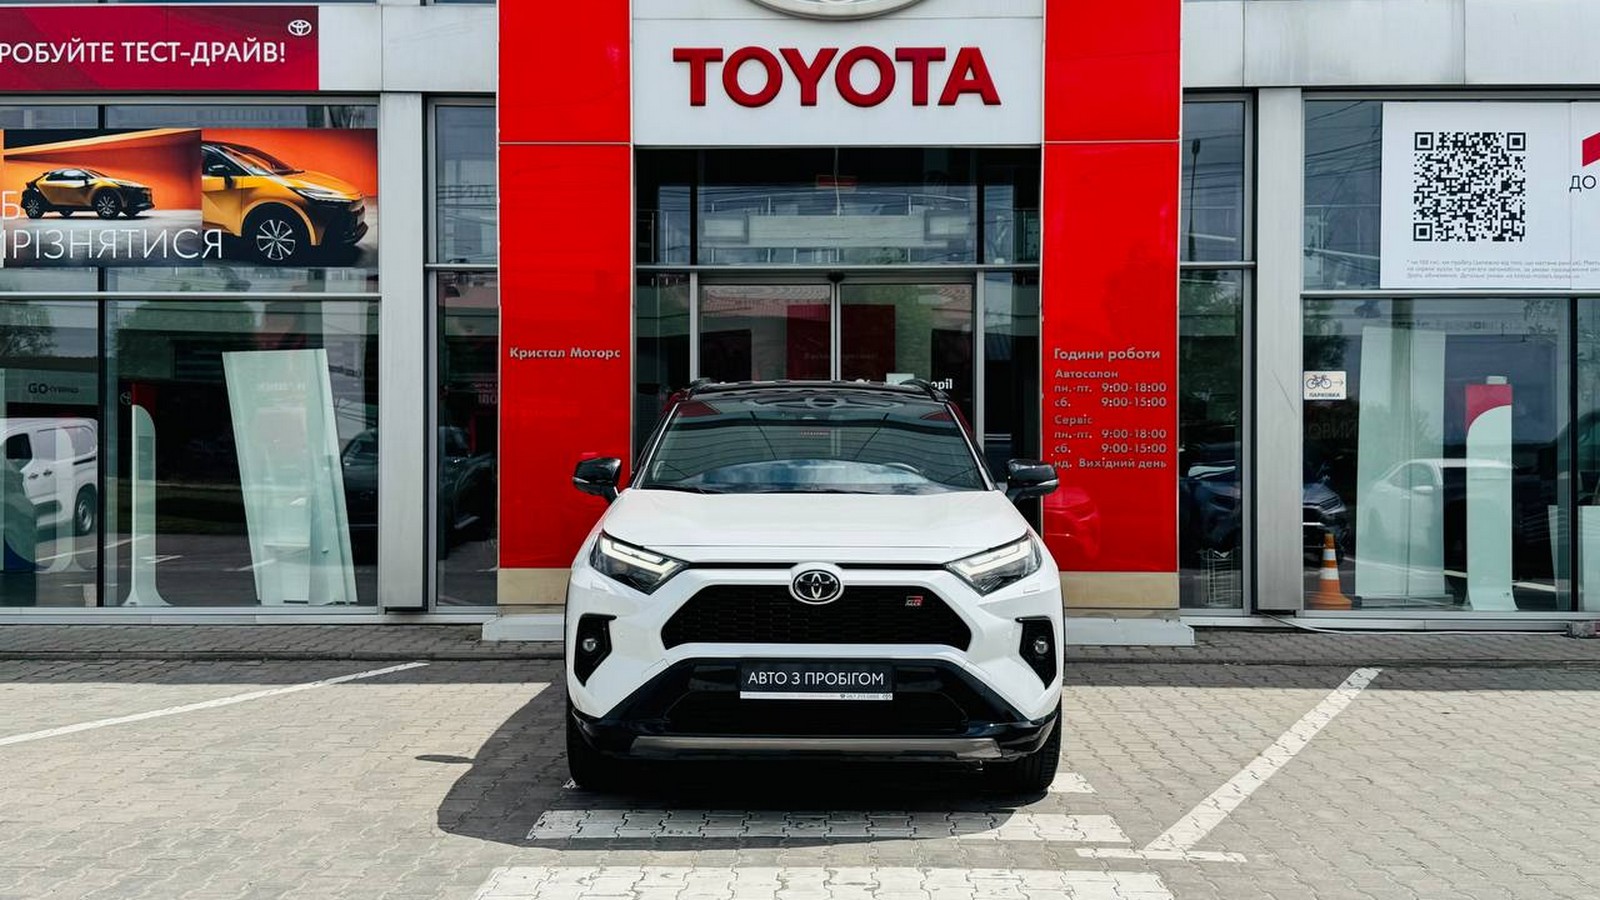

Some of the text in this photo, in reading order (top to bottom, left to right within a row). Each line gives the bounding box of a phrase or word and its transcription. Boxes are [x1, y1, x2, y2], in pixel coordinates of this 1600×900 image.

[0, 37, 286, 67] РОБУЙТЕ ТЕСТ-ДРАЙВ!
[672, 45, 1002, 108] TOYOTA
[1569, 175, 1597, 193] ДО
[509, 346, 621, 360] Кристал Моторс
[1054, 346, 1161, 362] Години роботи
[1054, 369, 1119, 379] Автосалон
[1054, 397, 1072, 407] сб.
[1054, 413, 1093, 426] Сервіс
[1054, 443, 1072, 453] сб.
[1054, 457, 1167, 470] нд. Вихідний день
[748, 671, 884, 686] АВТО З ПРОБІГОМ
